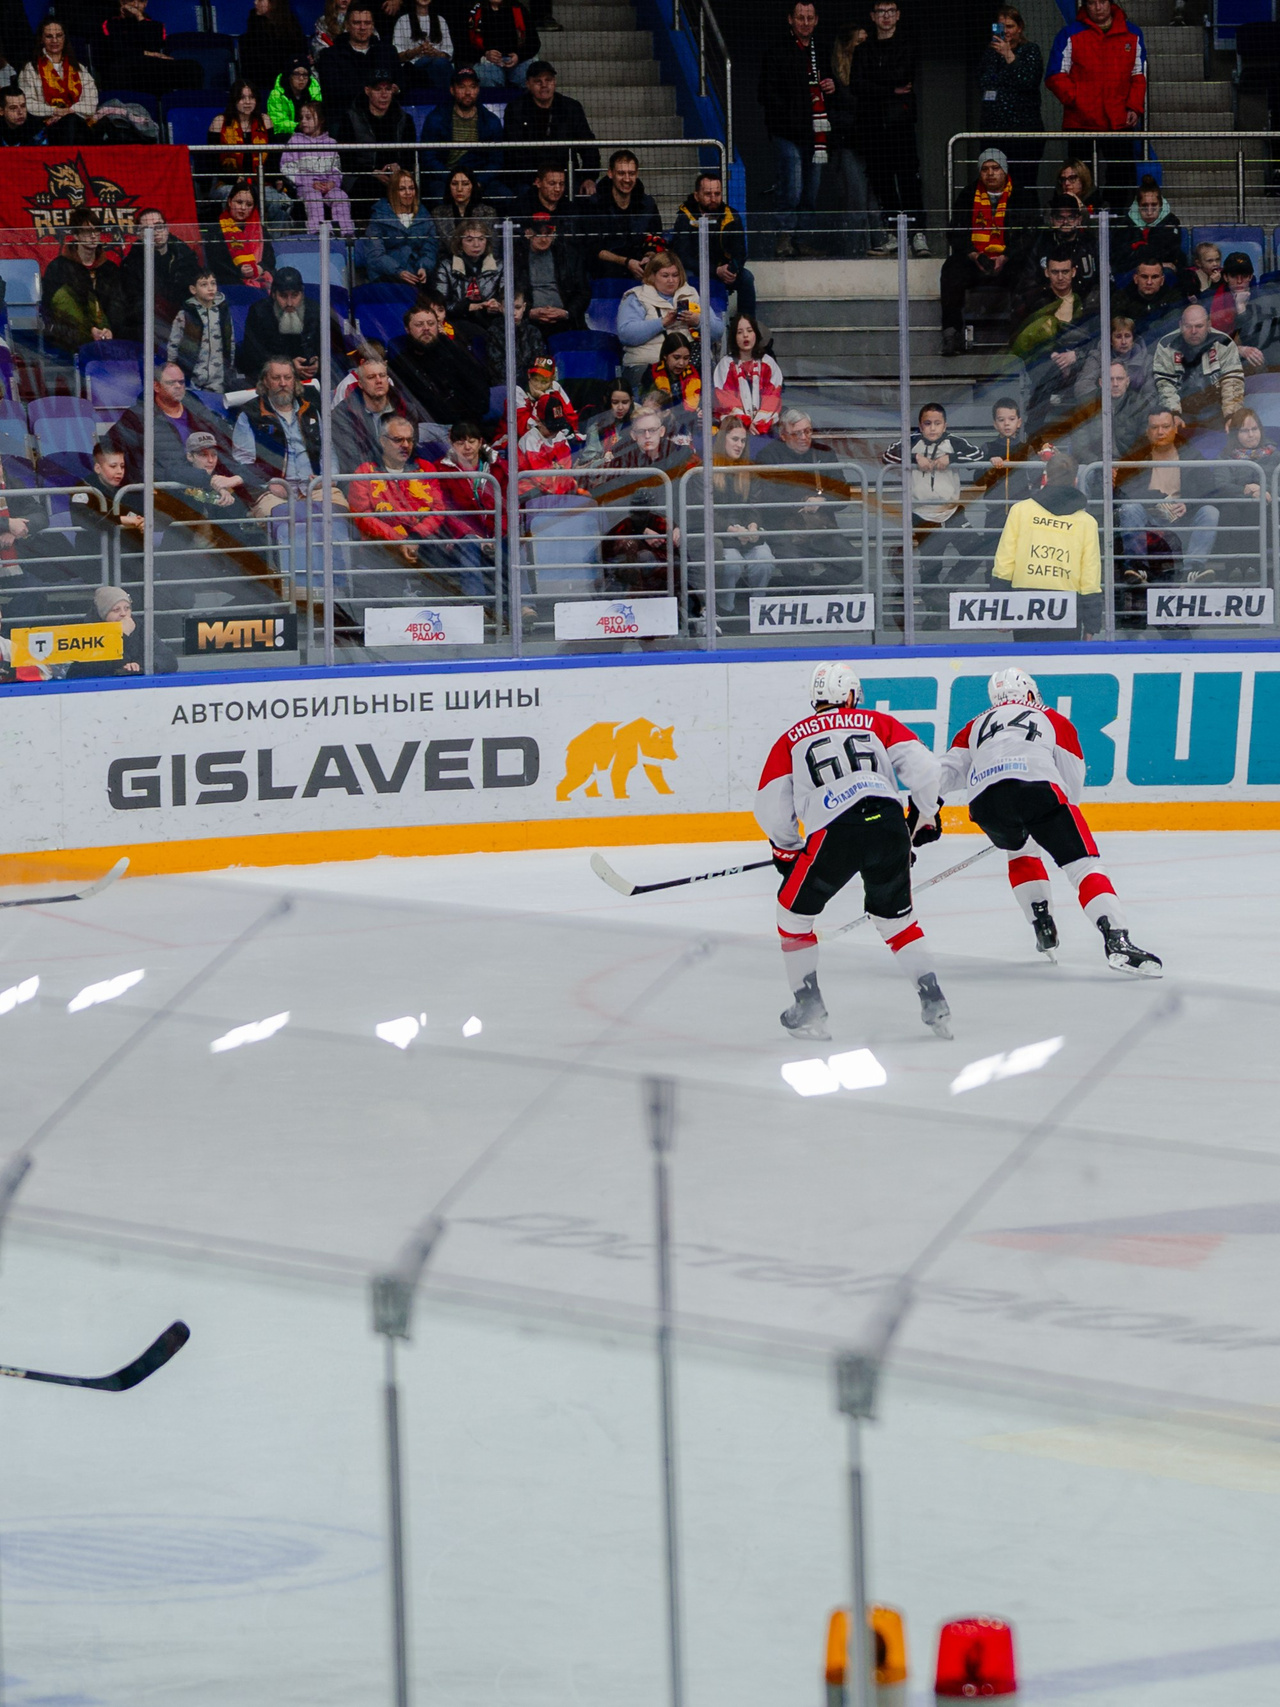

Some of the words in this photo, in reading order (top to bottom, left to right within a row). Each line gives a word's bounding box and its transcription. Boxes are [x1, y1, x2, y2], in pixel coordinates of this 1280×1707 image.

[25, 206, 140, 238] RETAR
[1032, 516, 1073, 531] SAFETY
[1030, 544, 1070, 563] K3721
[1027, 563, 1071, 580] SAFETY
[758, 601, 867, 626] KHL.RU
[957, 598, 1068, 622] KHL.RU
[1155, 594, 1265, 618] KHL.RU
[404, 623, 431, 633] АВТО
[596, 616, 623, 626] АВТО
[604, 624, 639, 634] РАДИО
[58, 636, 105, 651] БАНК
[198, 619, 285, 649] МАТЧ!
[412, 631, 445, 641] РАДИО
[171, 692, 434, 725] АВТОМОБИЛЬНЫЕ
[445, 687, 540, 710] ШИНЫ
[787, 713, 874, 742] CHISTYAKOV
[977, 710, 1042, 749] 44
[805, 733, 878, 788] 66
[107, 736, 540, 810] GISLAVED
[690, 866, 744, 883] CCM
